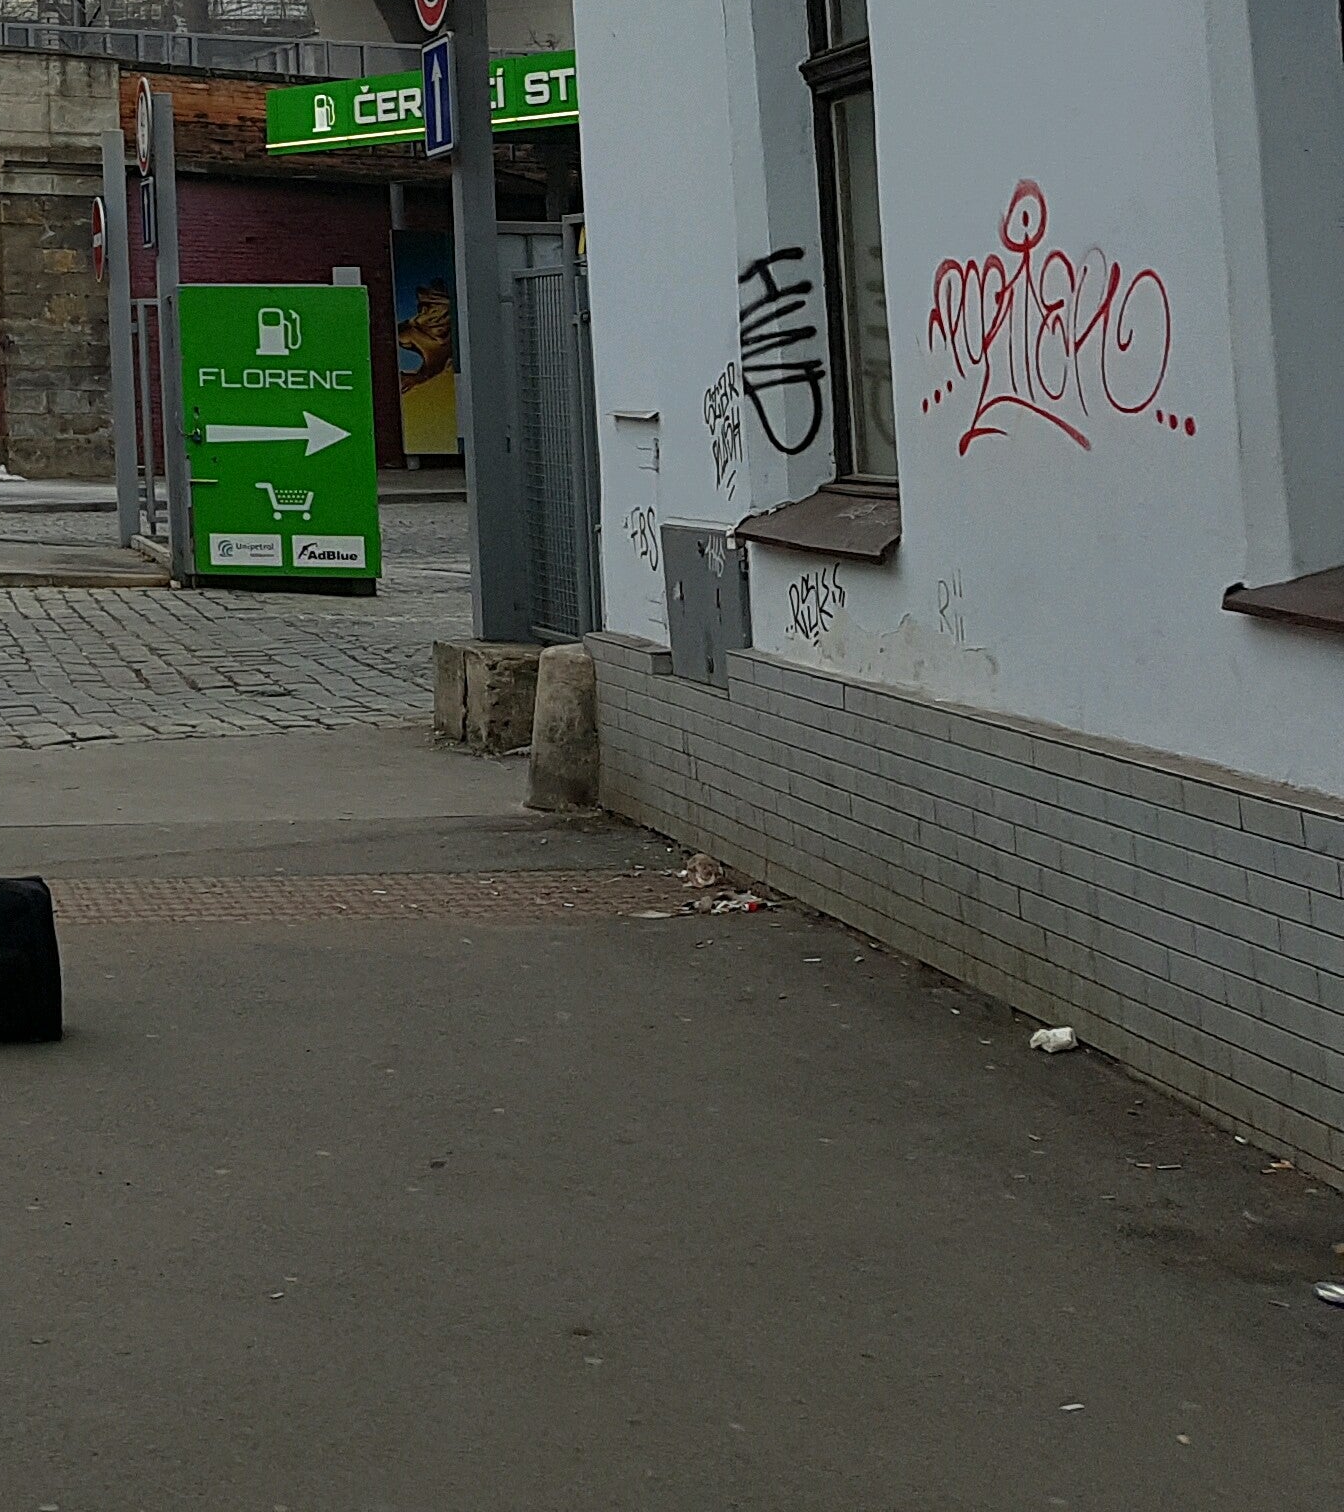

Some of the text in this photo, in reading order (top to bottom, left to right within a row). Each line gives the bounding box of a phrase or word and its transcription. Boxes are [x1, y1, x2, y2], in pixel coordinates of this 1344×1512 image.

[198, 367, 354, 391] FLORENC
[235, 542, 274, 552] Unipetrol
[307, 550, 358, 562] AdBlue
